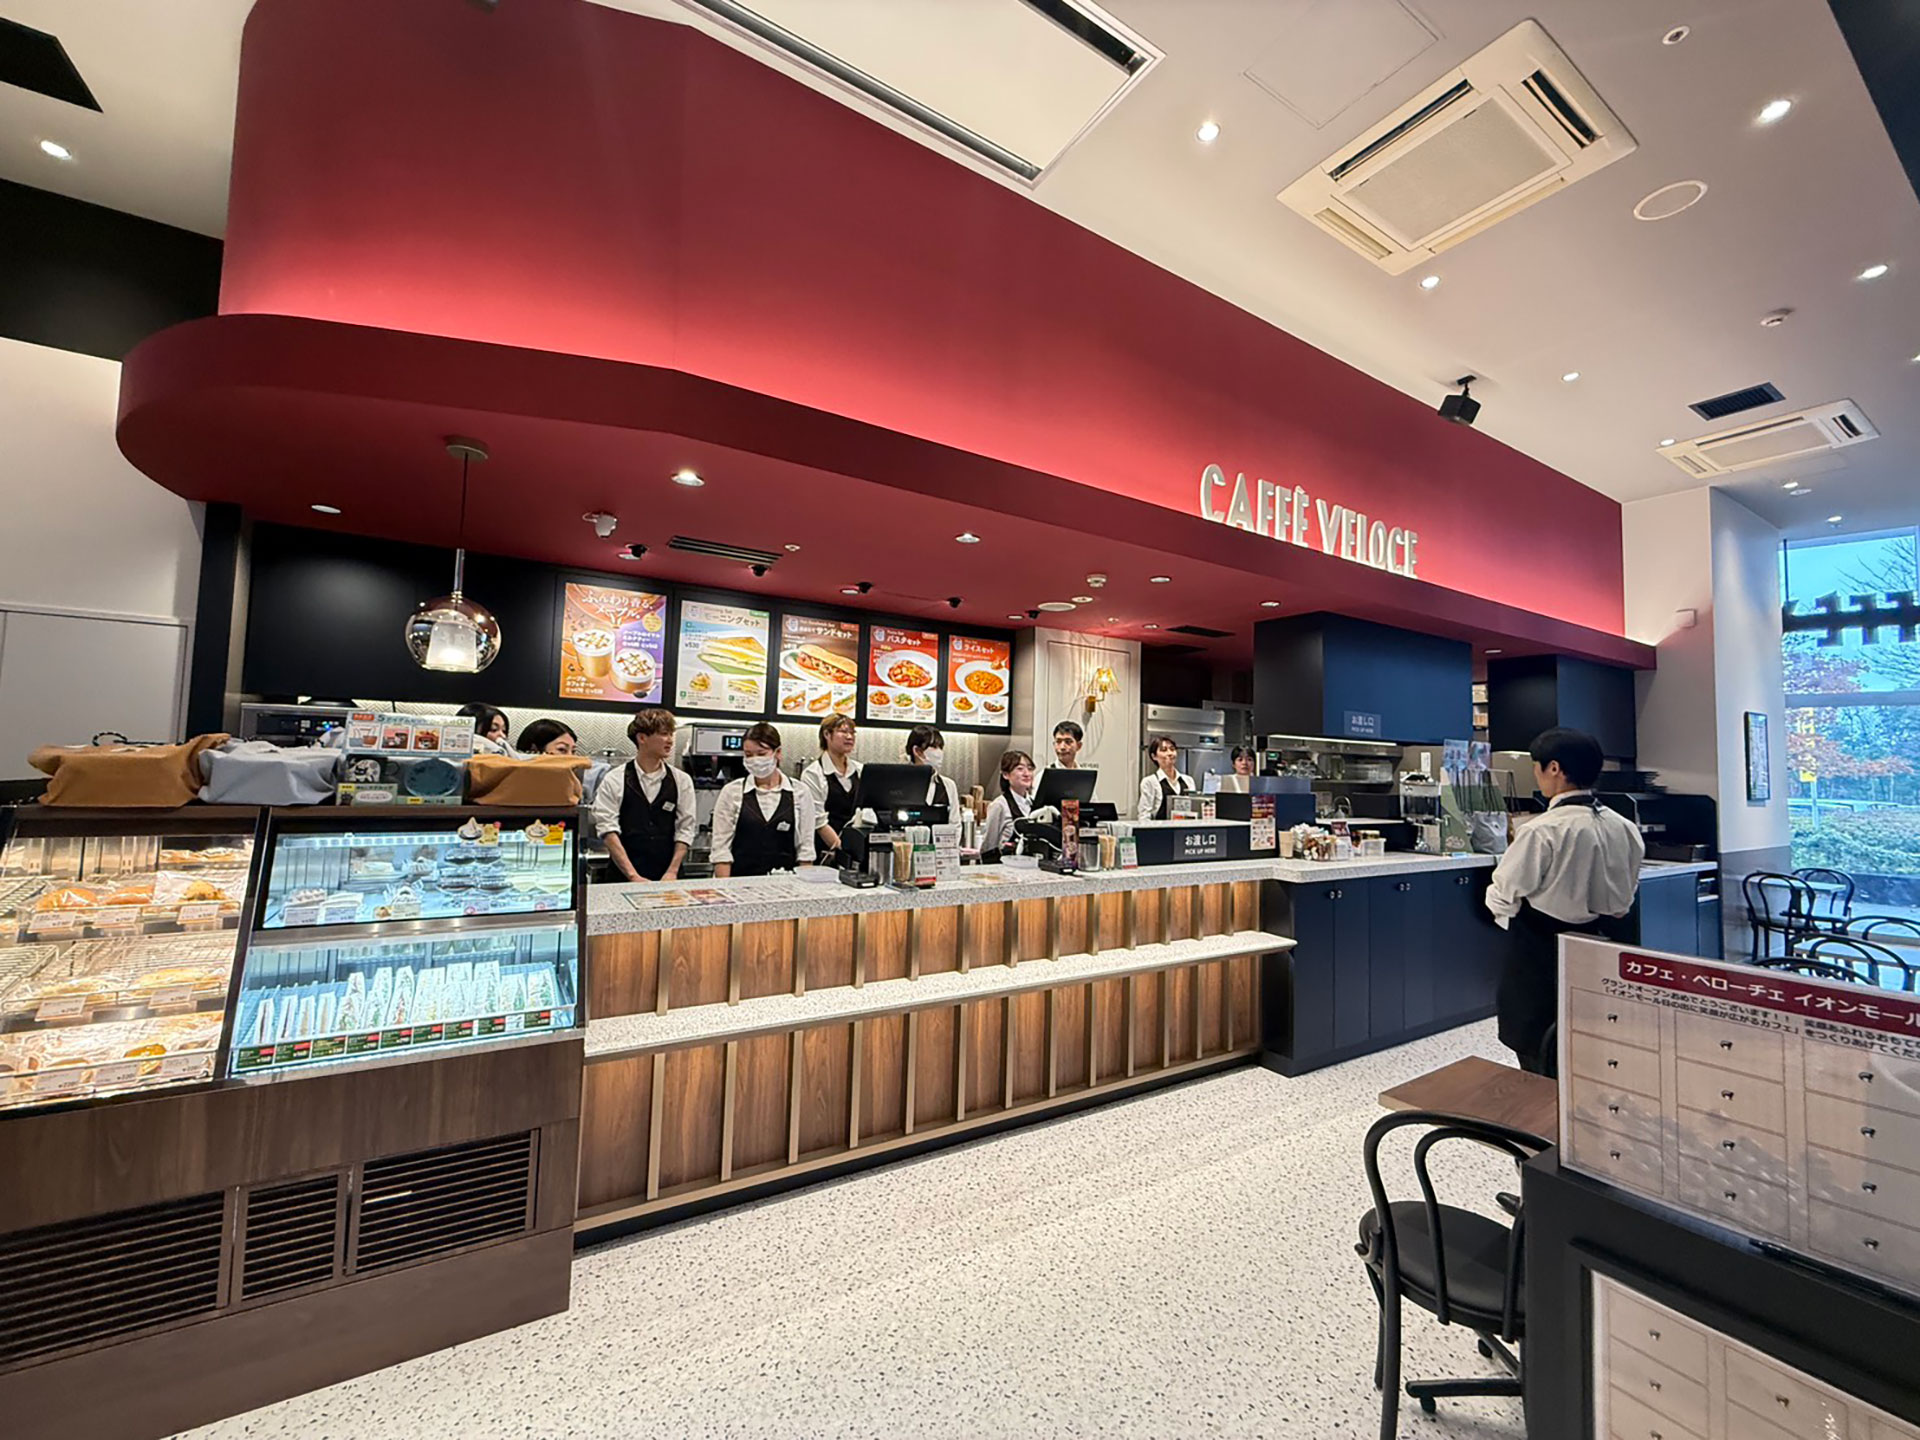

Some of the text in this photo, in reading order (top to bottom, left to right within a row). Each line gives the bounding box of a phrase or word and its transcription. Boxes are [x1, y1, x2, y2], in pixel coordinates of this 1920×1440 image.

[1200, 463, 1418, 579] CAFFÈ VELOCE
[887, 634, 921, 646] パスタセット
[1185, 834, 1217, 846] お渡し口
[1626, 961, 1785, 1002] カフェ・ベローチェ
